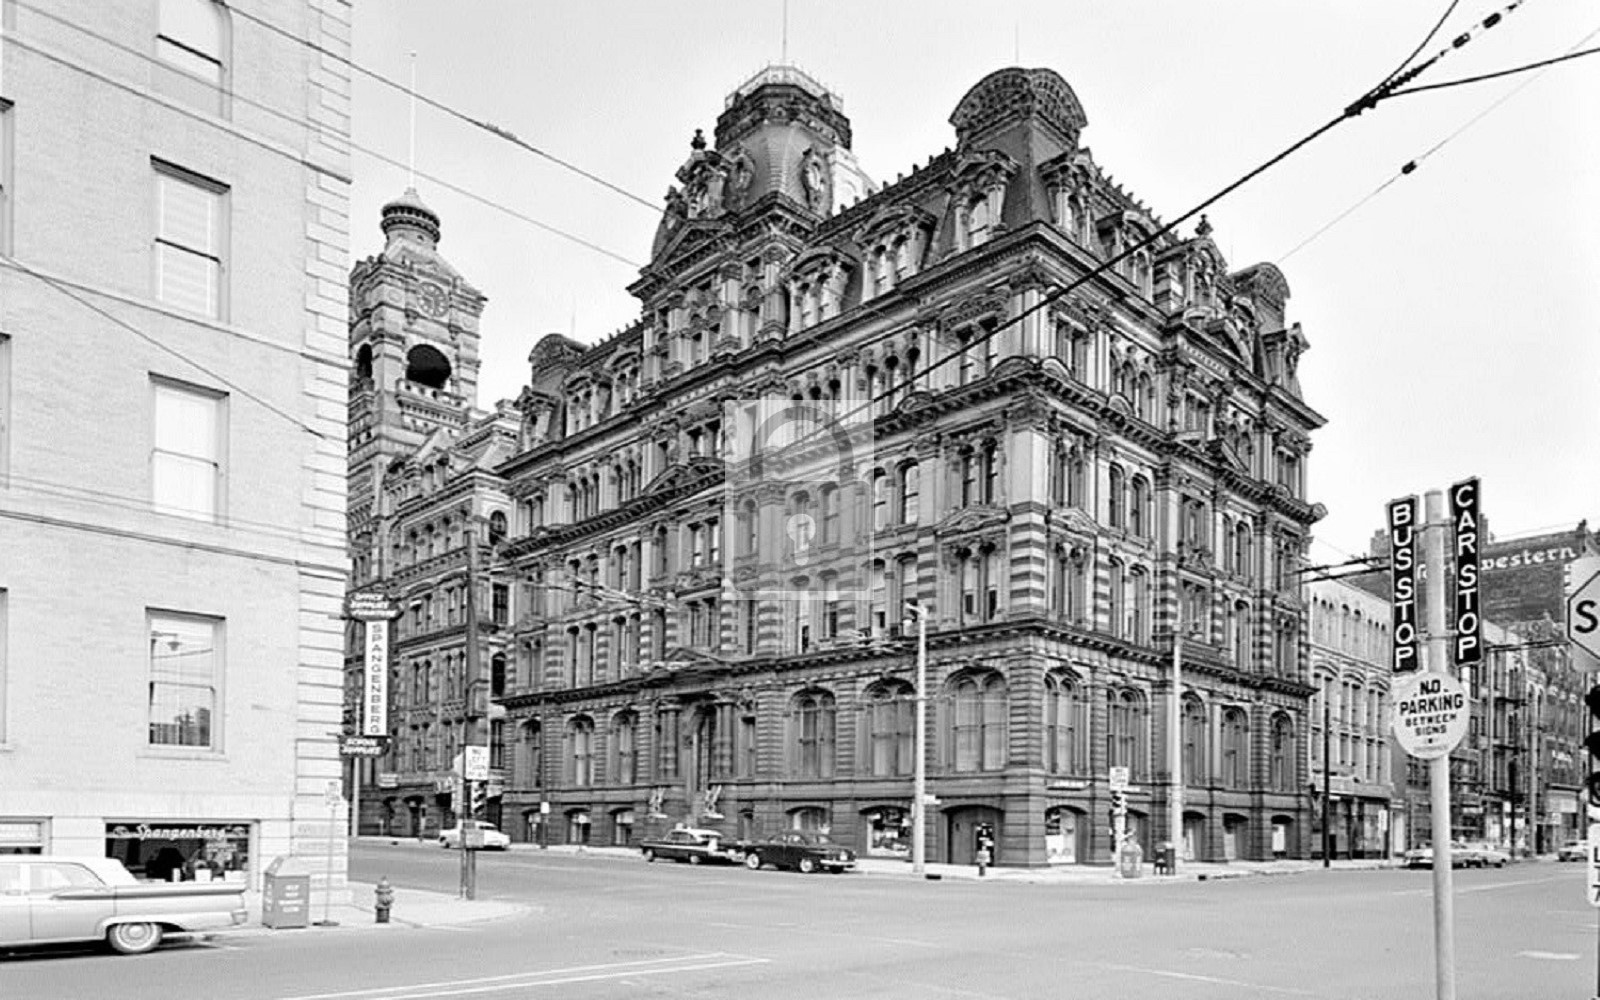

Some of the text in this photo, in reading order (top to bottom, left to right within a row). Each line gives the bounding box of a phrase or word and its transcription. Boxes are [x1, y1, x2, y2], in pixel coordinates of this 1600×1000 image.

[1455, 484, 1478, 660] CAR STOP
[1392, 503, 1414, 669] BUS STOP
[1420, 679, 1441, 695] NO
[1400, 693, 1464, 716] PARKING
[1405, 713, 1457, 727] BETWEEN
[1415, 724, 1447, 736] SIGNS
